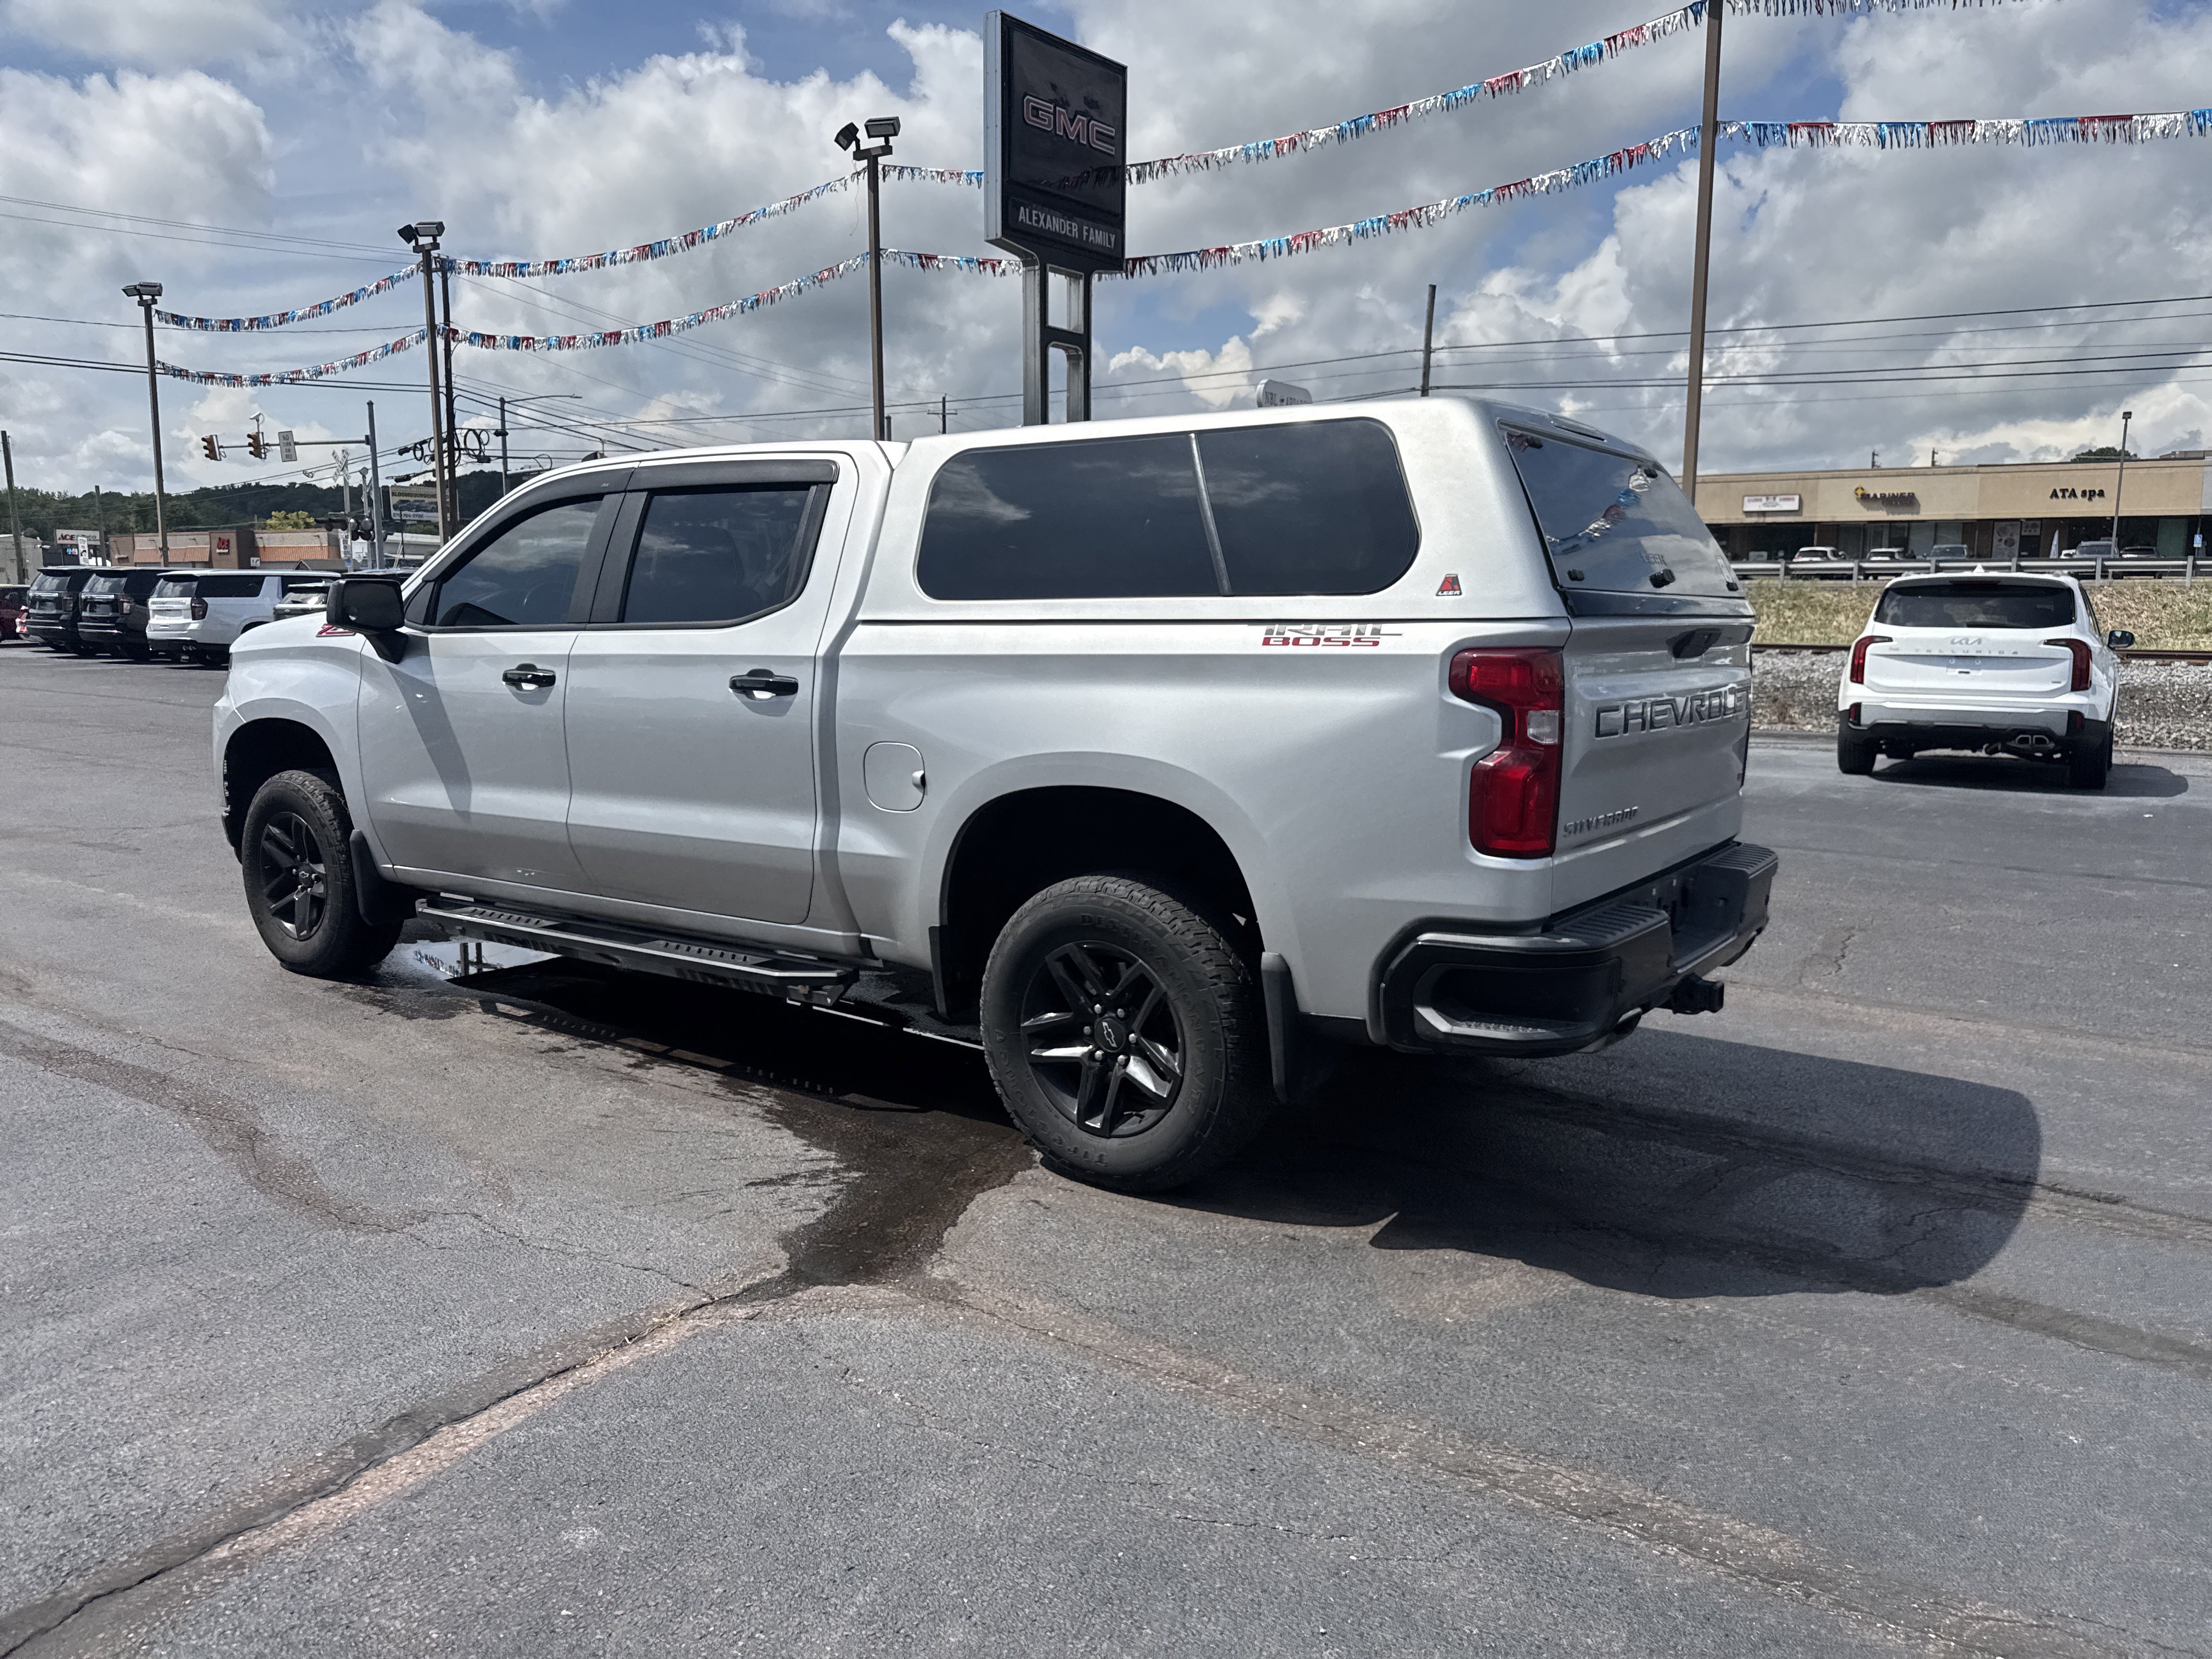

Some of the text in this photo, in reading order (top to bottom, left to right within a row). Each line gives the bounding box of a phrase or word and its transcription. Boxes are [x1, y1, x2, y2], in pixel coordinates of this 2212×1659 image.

[1024, 95, 1115, 154] GMC
[1018, 206, 1115, 249] ALEXANDER FAMILY
[332, 450, 349, 482] CROSSING
[2049, 488, 2106, 501] ATA spa
[217, 537, 229, 549] ACE
[1262, 636, 1381, 647] BOSS
